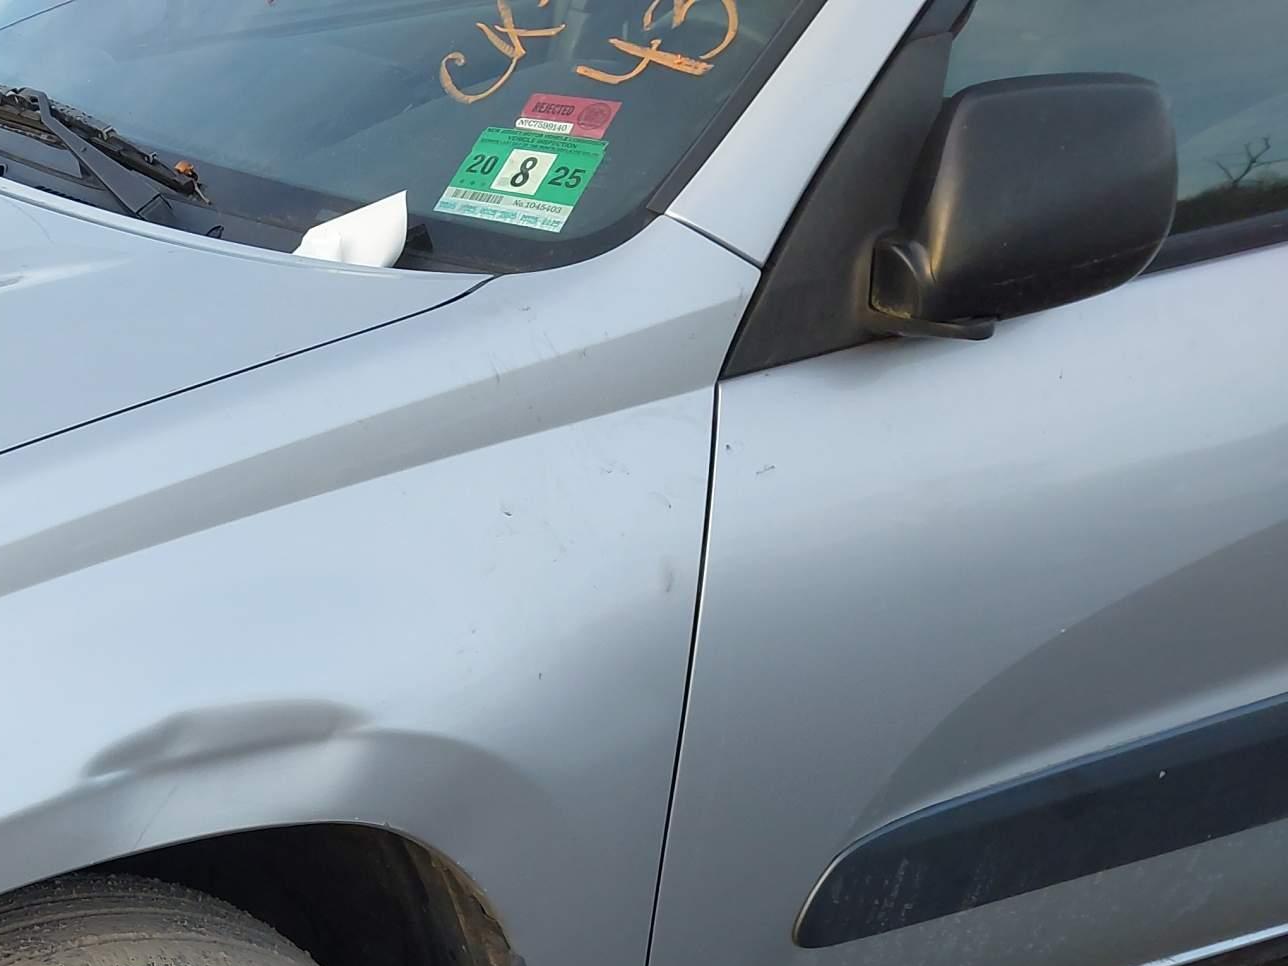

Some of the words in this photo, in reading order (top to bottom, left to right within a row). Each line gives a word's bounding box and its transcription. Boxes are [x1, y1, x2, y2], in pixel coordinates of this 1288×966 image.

[531, 102, 575, 117] REJECTED
[466, 154, 499, 176] 20
[510, 156, 538, 188] 8
[547, 166, 586, 189] 25
